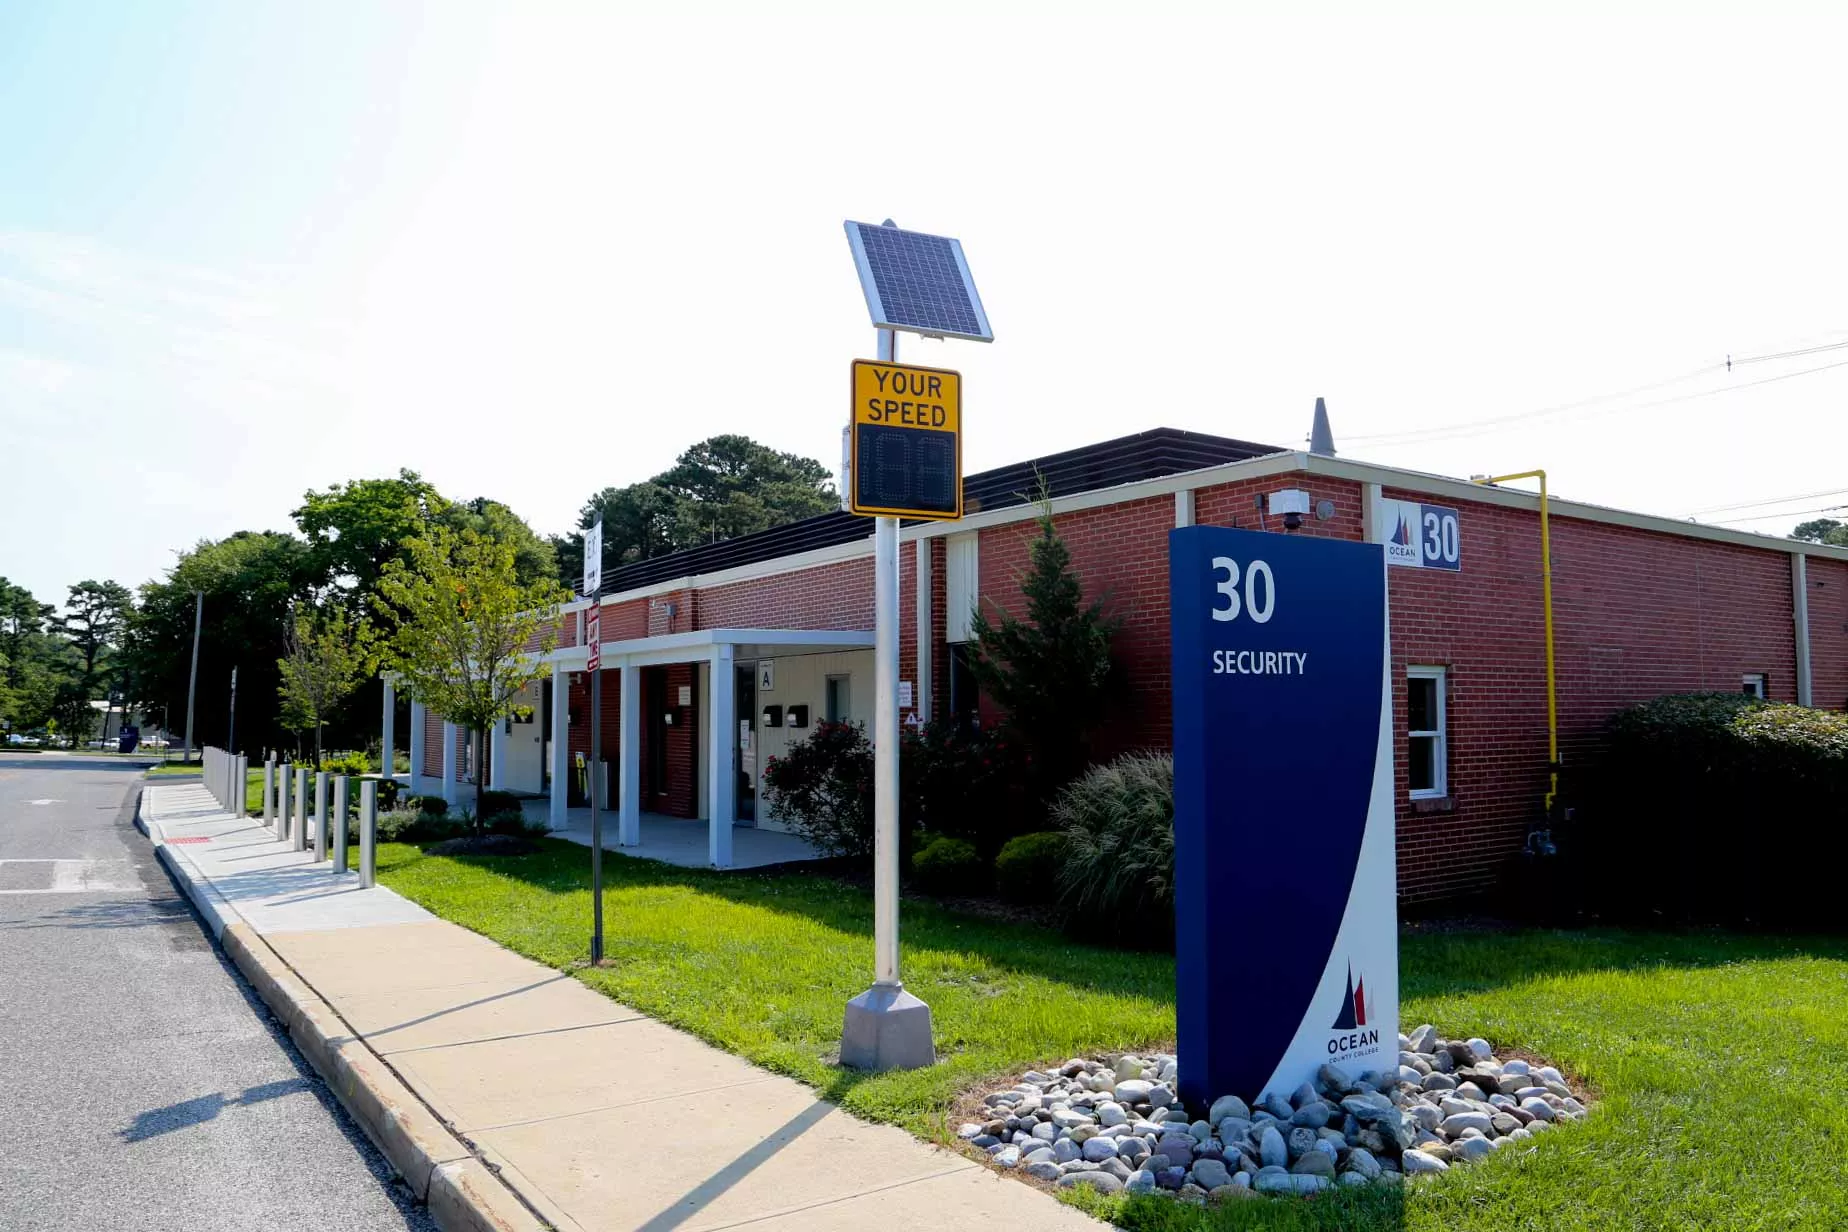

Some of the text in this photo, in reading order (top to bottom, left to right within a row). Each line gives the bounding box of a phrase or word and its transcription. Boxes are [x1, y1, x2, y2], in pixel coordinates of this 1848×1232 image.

[873, 369, 942, 398] YOUR
[868, 398, 946, 427] SPEED
[1424, 512, 1459, 563] 30
[1389, 546, 1416, 557] OCEAN
[1212, 556, 1276, 624] 30
[1212, 650, 1307, 675] SECURITY
[762, 671, 770, 687] A
[1327, 1029, 1379, 1055] OCEAN
[1328, 1046, 1379, 1064] COUNTY COLLEGE
